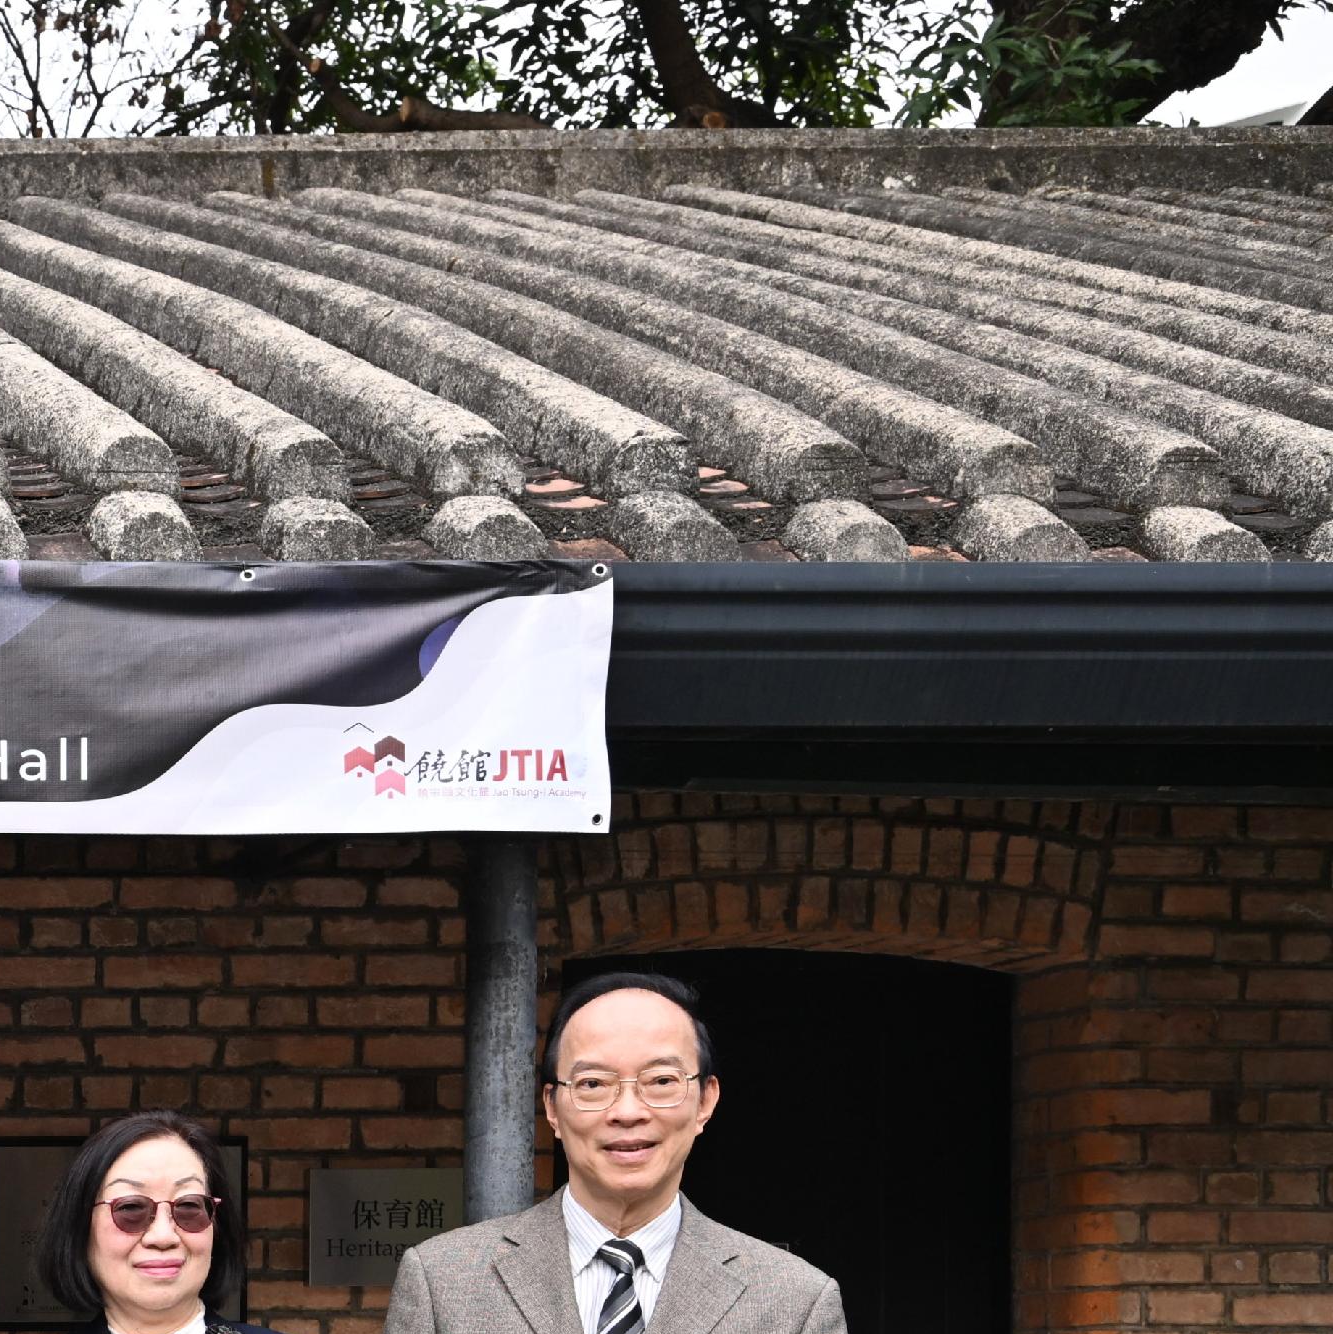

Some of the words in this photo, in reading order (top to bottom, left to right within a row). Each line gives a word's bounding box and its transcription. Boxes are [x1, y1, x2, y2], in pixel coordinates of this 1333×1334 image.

[492, 749, 568, 781] JTIA
[352, 1199, 445, 1230] 保育館
